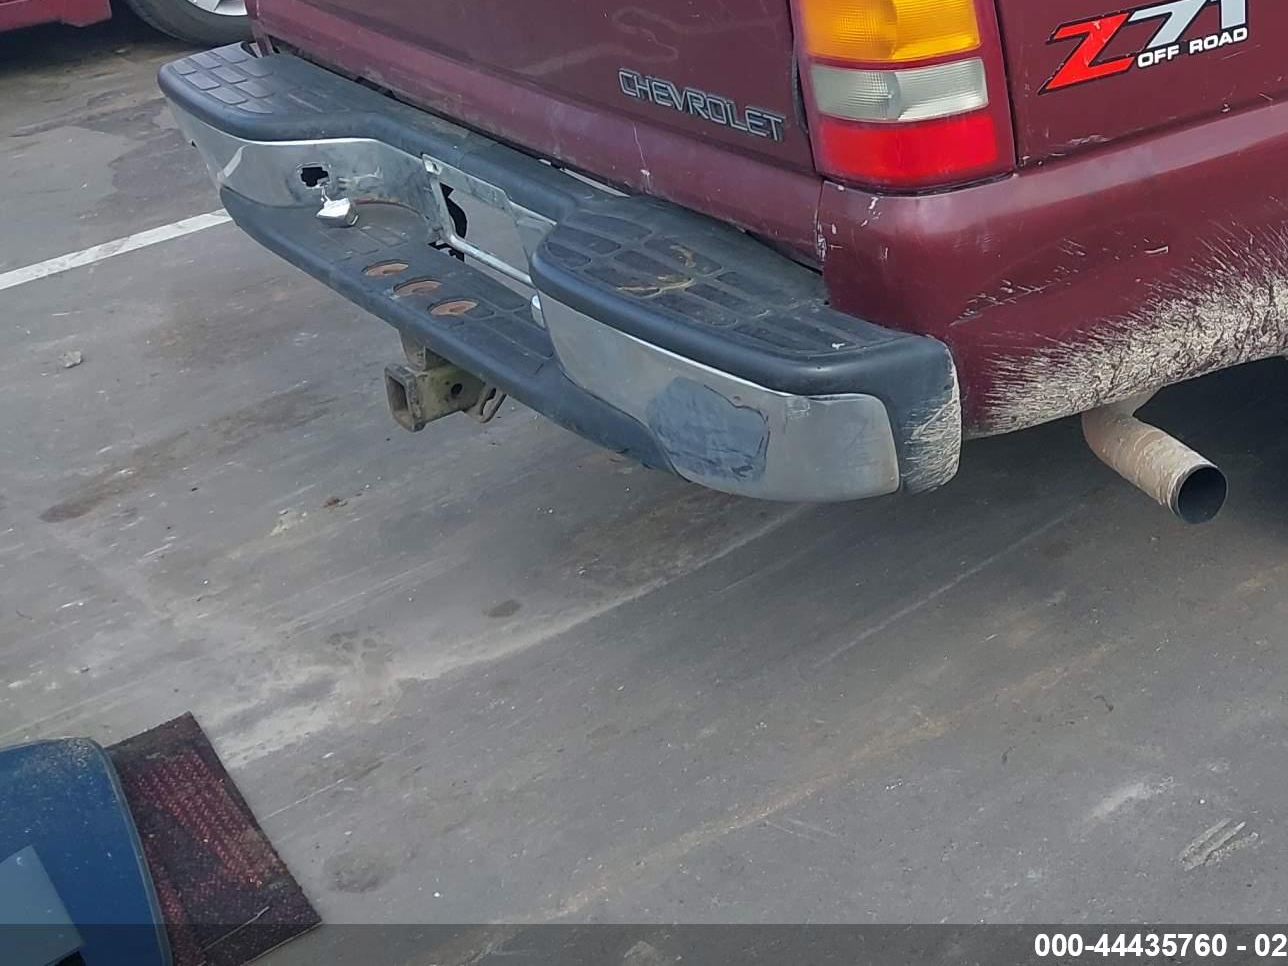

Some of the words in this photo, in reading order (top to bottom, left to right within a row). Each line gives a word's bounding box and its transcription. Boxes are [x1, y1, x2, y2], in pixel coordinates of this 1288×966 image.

[1136, 45, 1180, 69] OFF
[1189, 27, 1248, 54] ROAD
[618, 68, 786, 141] CHEVROLET
